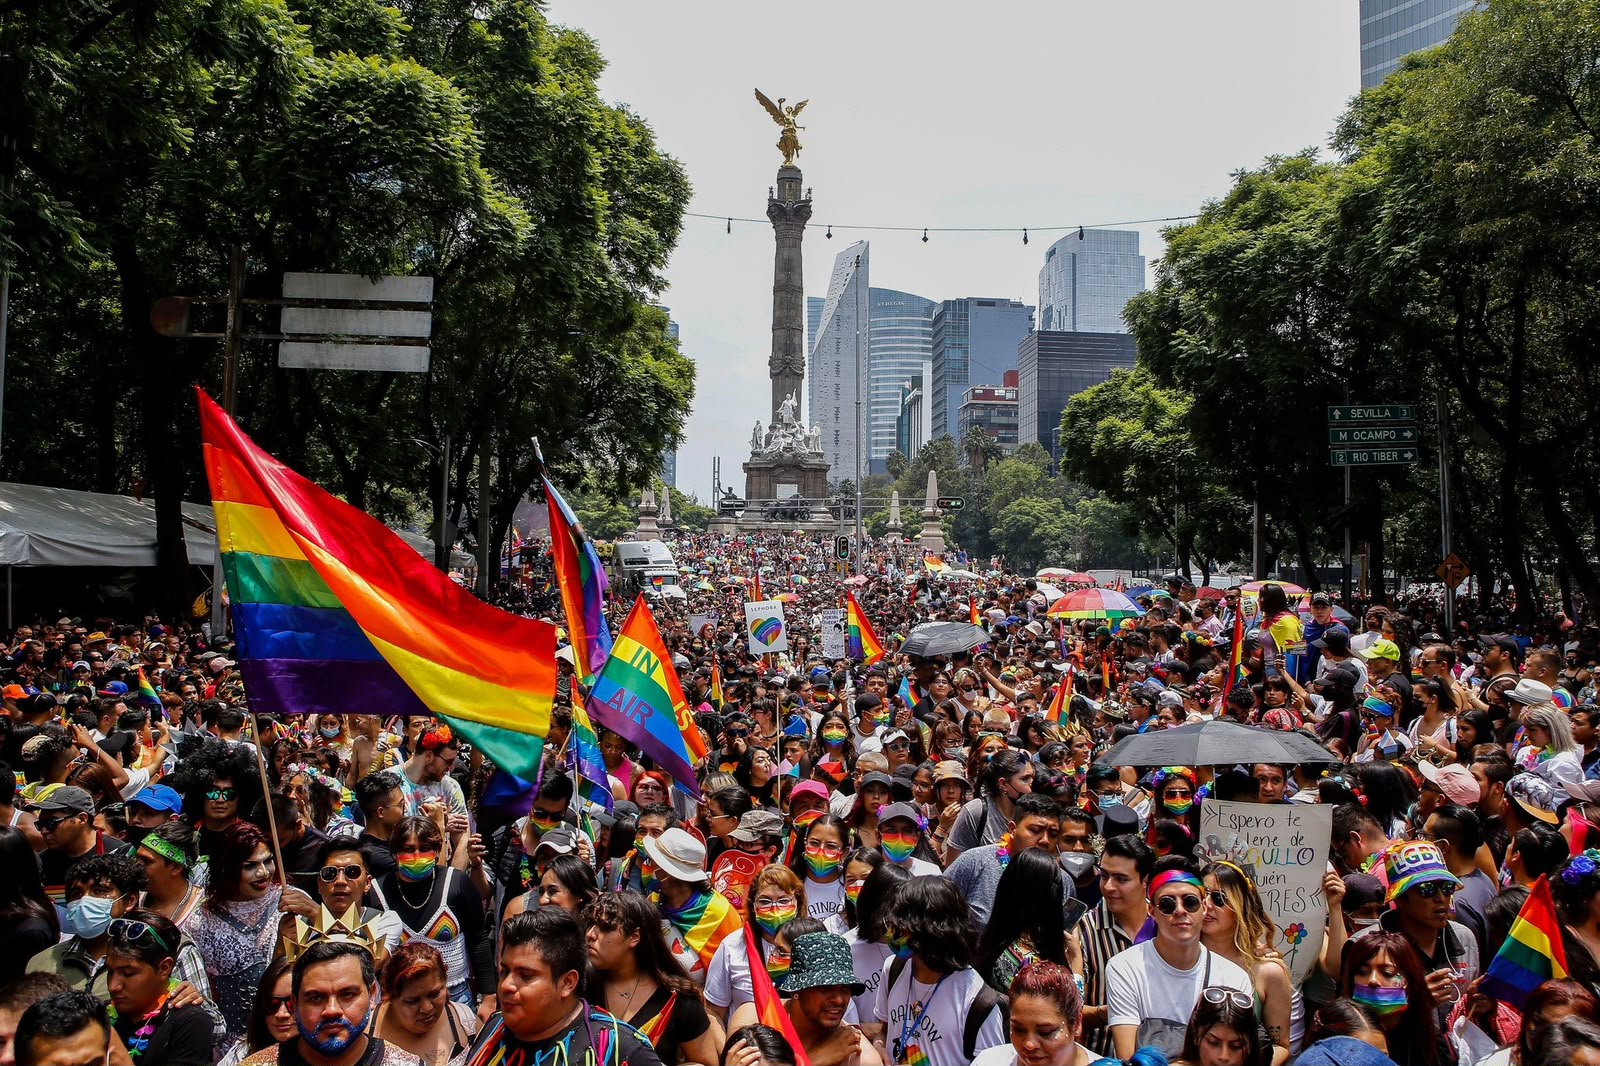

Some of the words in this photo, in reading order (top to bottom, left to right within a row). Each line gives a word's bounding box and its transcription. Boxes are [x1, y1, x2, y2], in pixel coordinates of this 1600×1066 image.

[1350, 408, 1391, 418] SEVILLA
[1402, 409, 1407, 417] 3
[1339, 431, 1348, 441] M
[1353, 430, 1396, 440] OCAMPO
[1338, 454, 1345, 462] 2
[1352, 452, 1368, 462] RIO
[1372, 451, 1398, 461] TIBER
[630, 646, 660, 677] IN
[607, 687, 654, 730] AIR
[674, 700, 693, 731] IS
[1286, 810, 1303, 827] te
[1290, 831, 1304, 847] de
[1255, 871, 1286, 887] uién
[808, 901, 844, 917] AINBO
